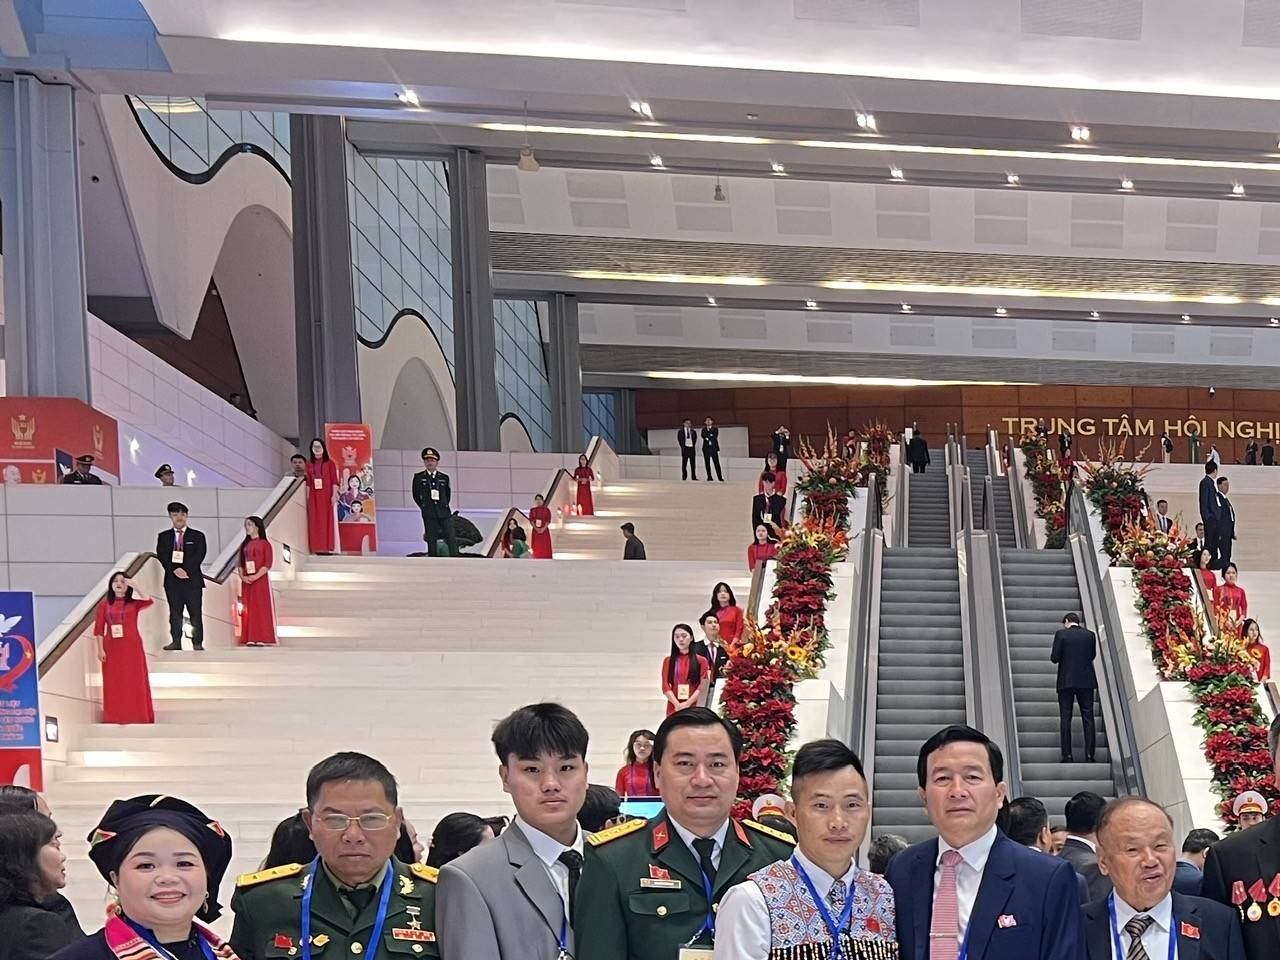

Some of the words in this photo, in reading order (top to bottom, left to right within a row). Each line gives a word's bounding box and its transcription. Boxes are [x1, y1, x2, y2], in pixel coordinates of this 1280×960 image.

[1002, 416, 1096, 436] TRUNG
[1102, 414, 1155, 437] TÂM
[1217, 420, 1280, 445] NGHỊ
